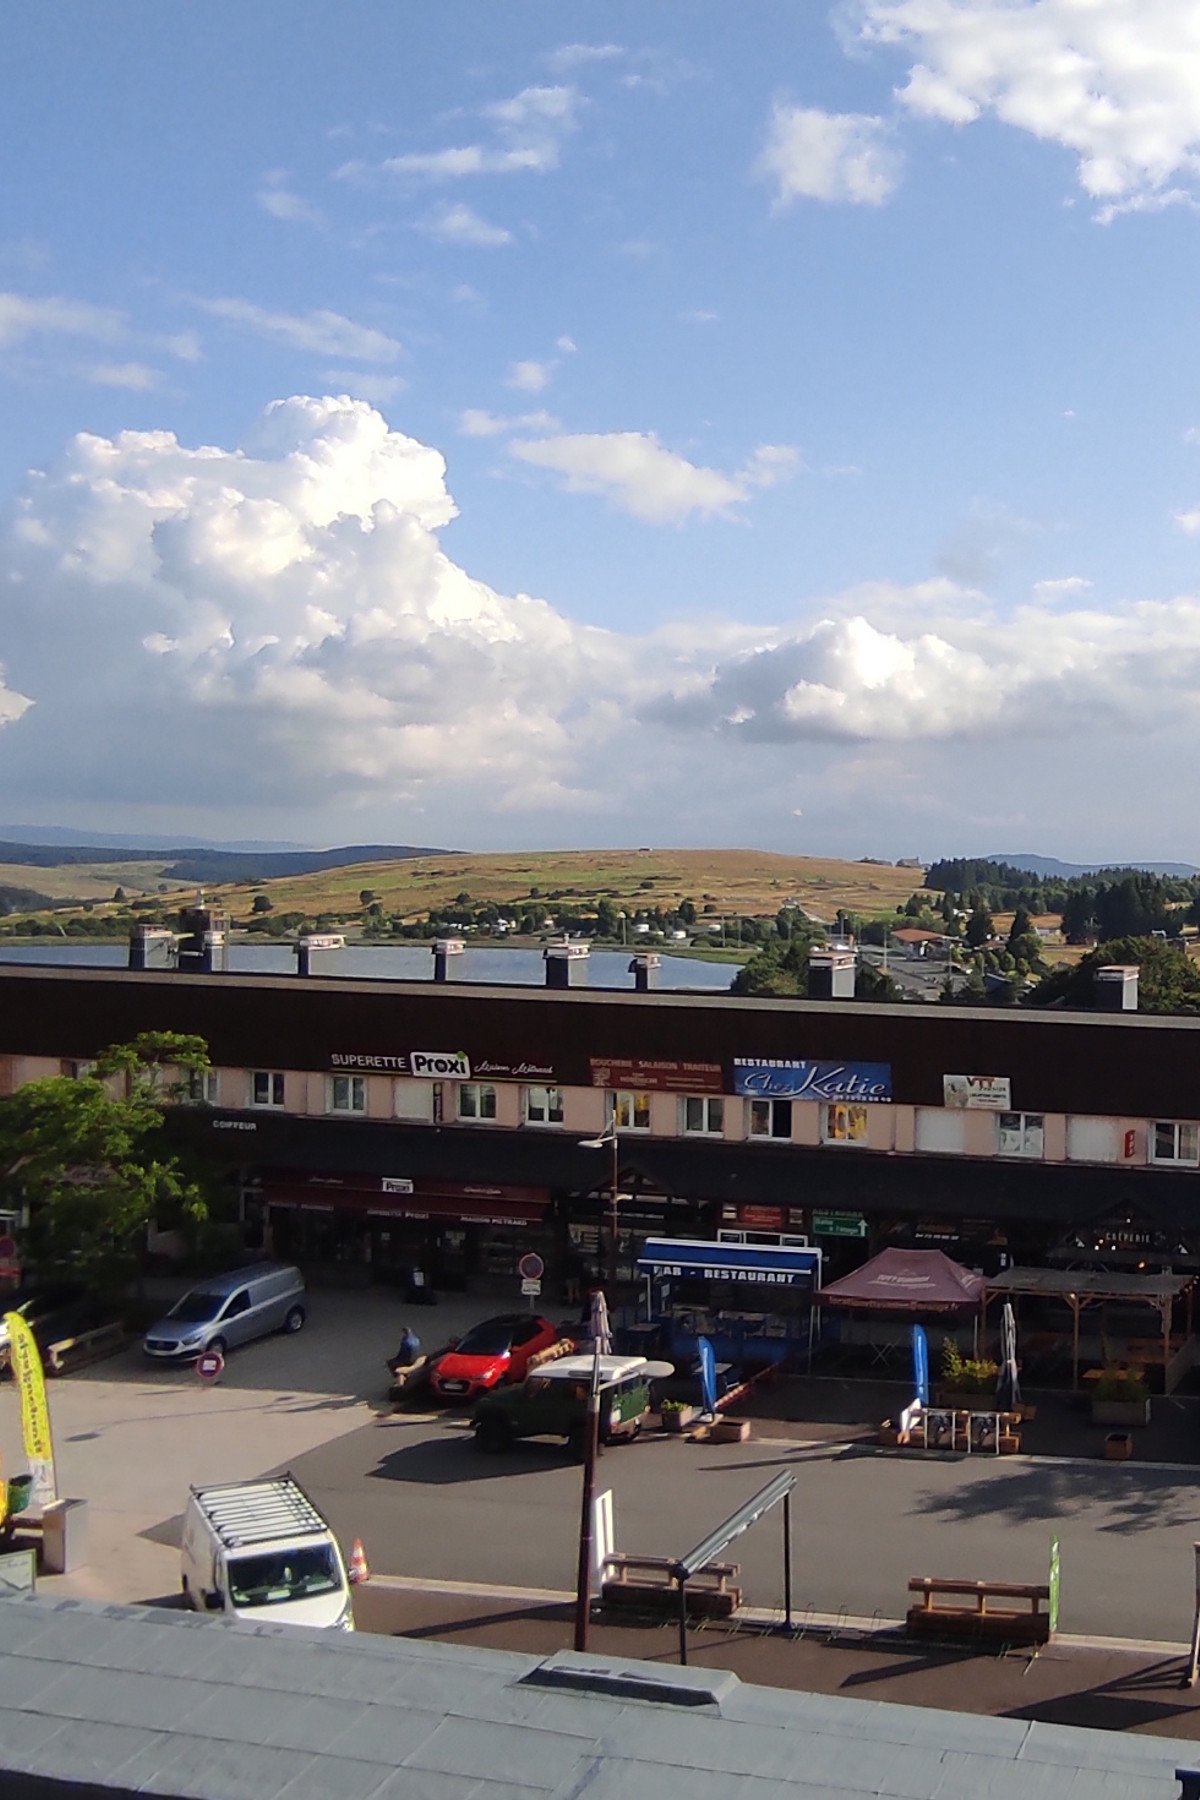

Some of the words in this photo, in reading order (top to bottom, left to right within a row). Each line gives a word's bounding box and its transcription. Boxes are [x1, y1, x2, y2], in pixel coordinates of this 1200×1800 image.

[331, 1053, 407, 1069] SUPERETTE
[414, 1054, 467, 1075] Proxi
[734, 1058, 806, 1069] RESTAURANT
[967, 1077, 995, 1088] VTT
[212, 1120, 257, 1131] COIFFEUR
[704, 1269, 795, 1284] RESTAURANT
